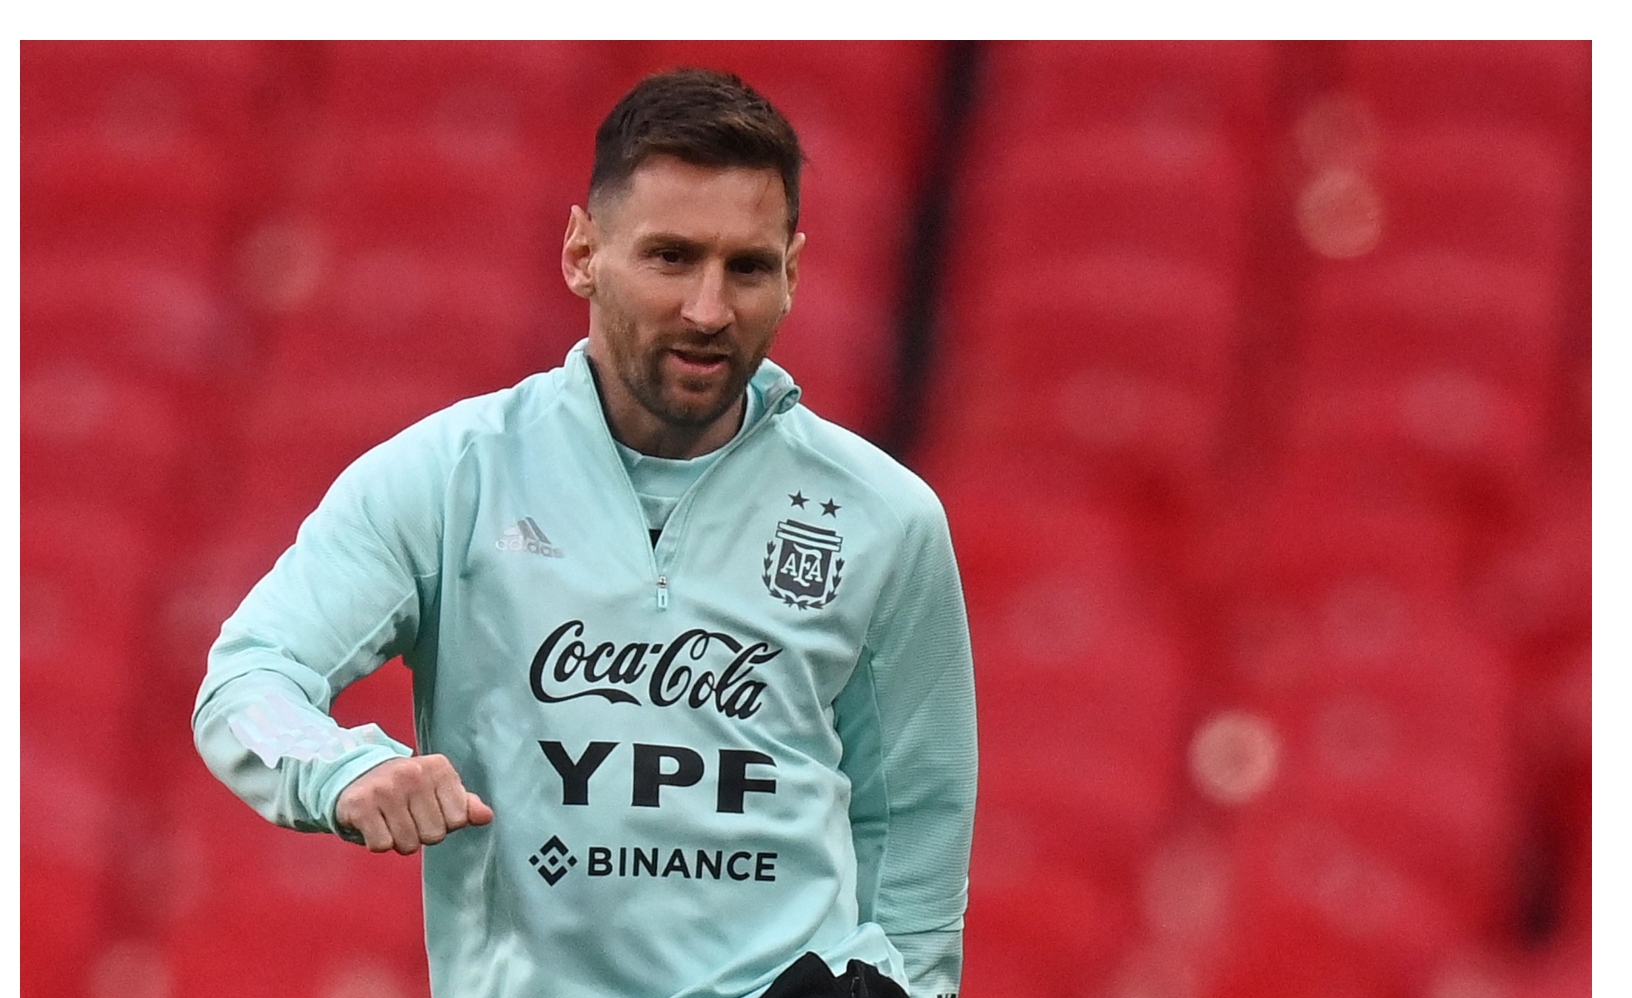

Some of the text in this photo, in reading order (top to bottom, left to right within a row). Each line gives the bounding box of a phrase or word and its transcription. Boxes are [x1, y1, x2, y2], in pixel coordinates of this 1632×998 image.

[780, 543, 823, 587] AFA
[529, 619, 784, 720] Coca-Cola
[537, 739, 778, 815] YPF
[586, 846, 779, 883] BINANCE
